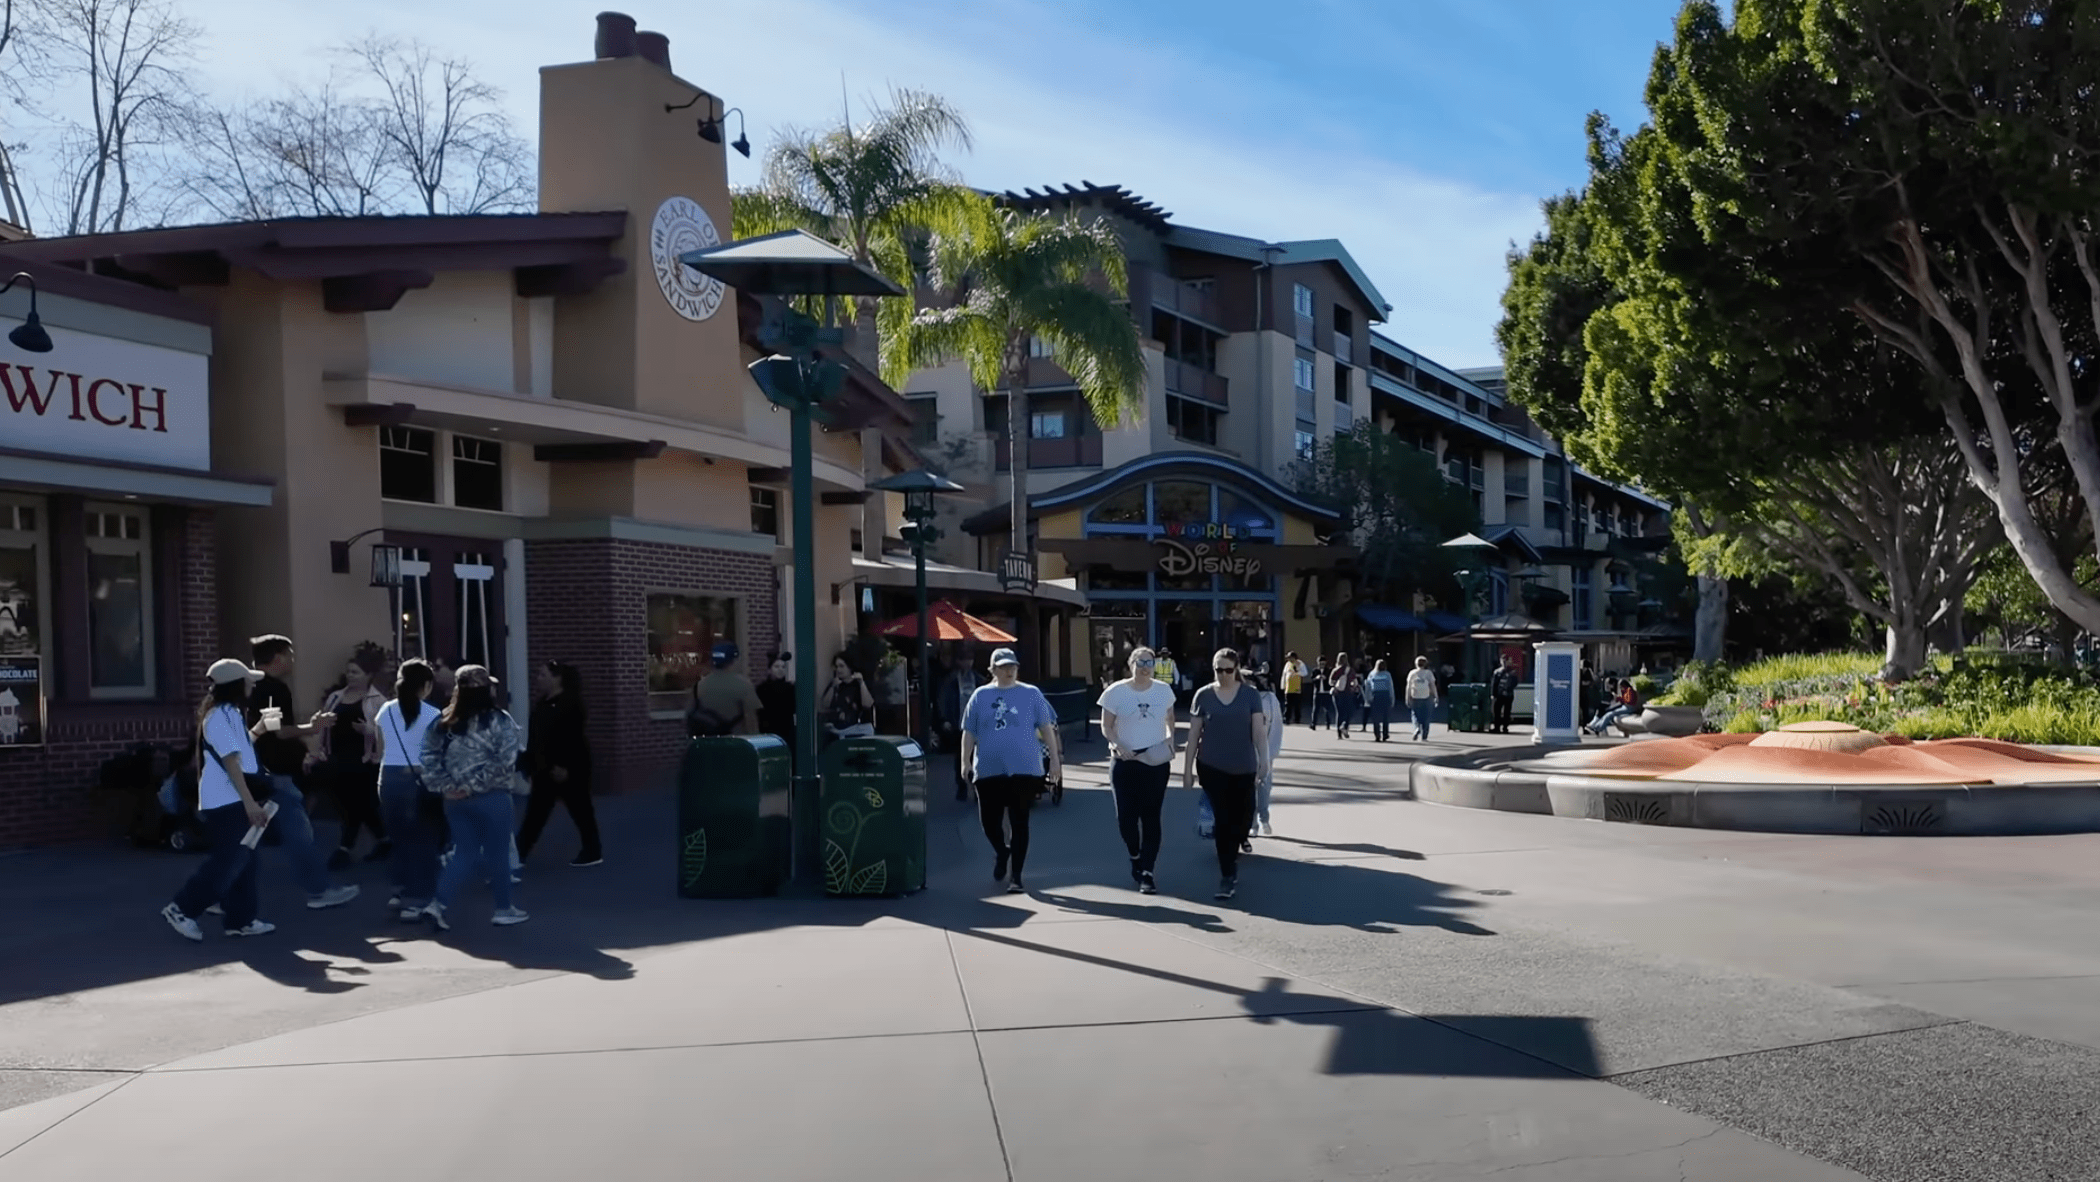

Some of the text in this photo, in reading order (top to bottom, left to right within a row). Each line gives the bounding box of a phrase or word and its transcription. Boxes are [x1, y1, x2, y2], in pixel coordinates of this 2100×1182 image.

[660, 201, 699, 228] EARL
[655, 254, 722, 317] SANDWICH
[0, 363, 168, 433] WICH
[1166, 522, 1251, 540] WORLD
[1217, 541, 1237, 554] OF
[1004, 559, 1032, 581] TAVERN
